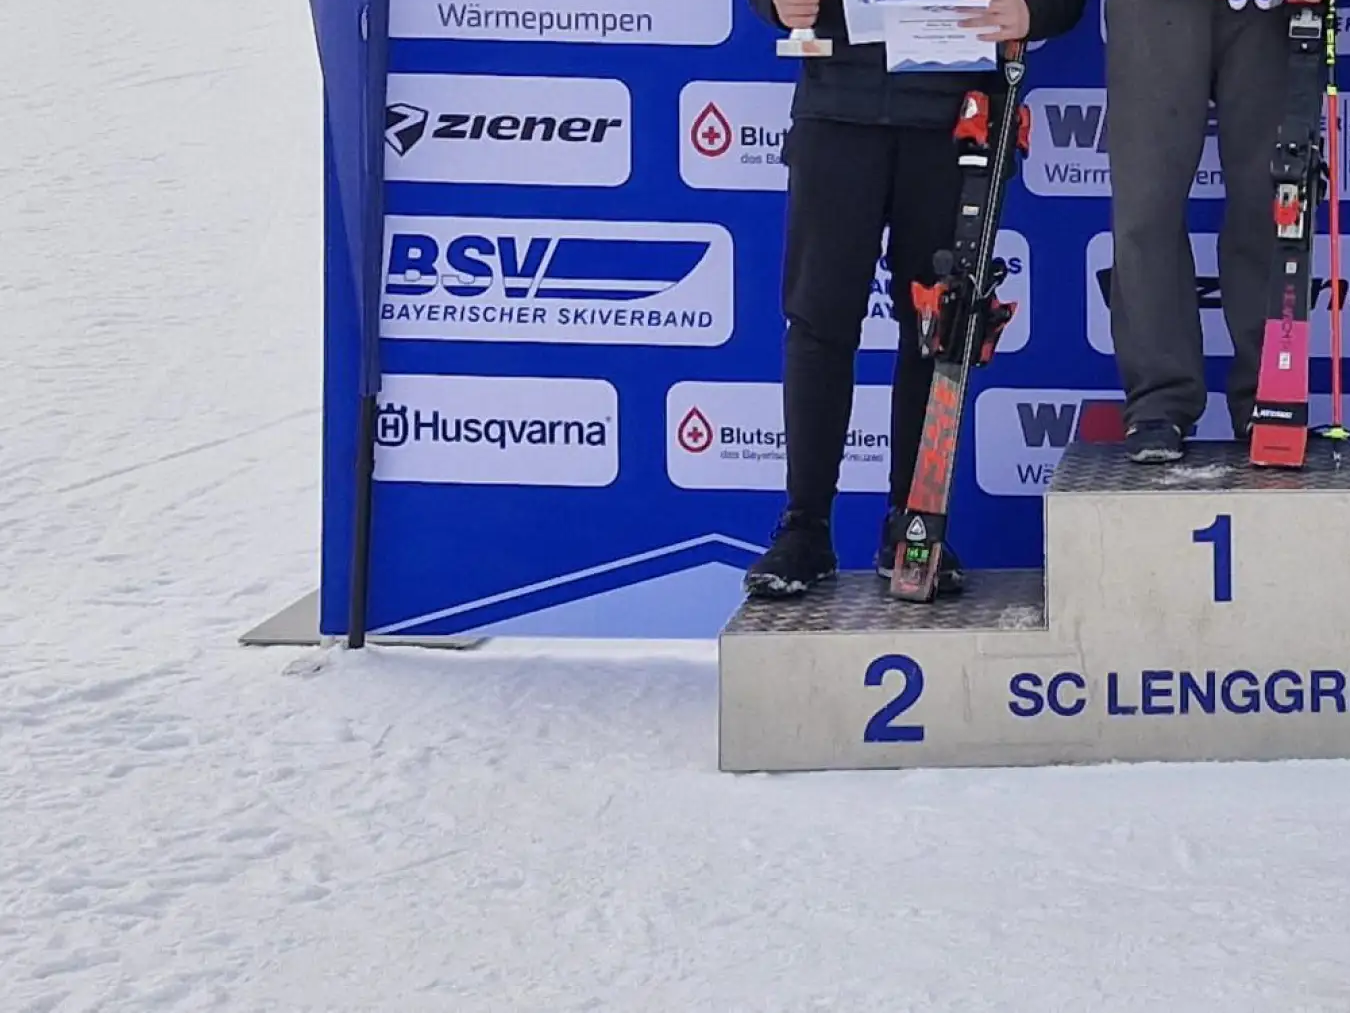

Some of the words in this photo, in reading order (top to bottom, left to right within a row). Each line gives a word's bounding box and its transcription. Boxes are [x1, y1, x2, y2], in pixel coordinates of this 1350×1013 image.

[437, 2, 652, 37] Wärmepumpen
[432, 113, 623, 143] ziener
[386, 232, 553, 299] BSV
[380, 302, 547, 326] BAYERISCHER
[557, 307, 713, 329] SKIVERBAND
[414, 410, 606, 449] Husqvarna
[1192, 514, 1233, 603] 1
[863, 653, 925, 743] 2
[1008, 672, 1087, 717] SC
